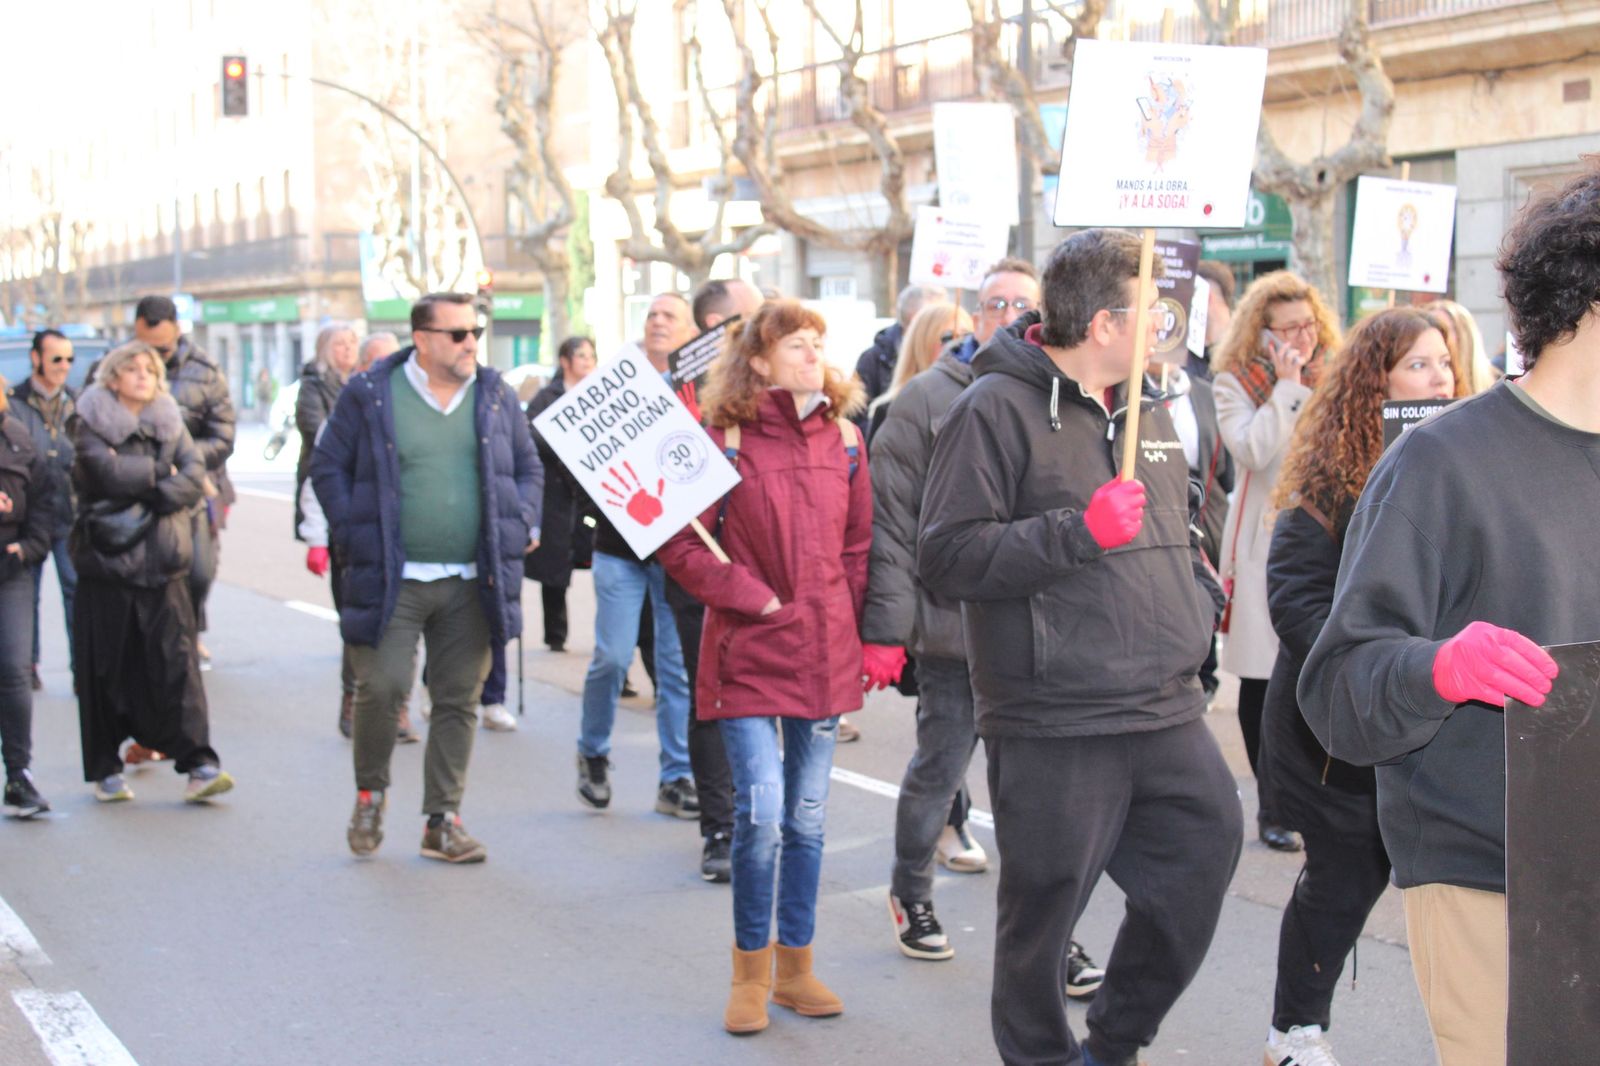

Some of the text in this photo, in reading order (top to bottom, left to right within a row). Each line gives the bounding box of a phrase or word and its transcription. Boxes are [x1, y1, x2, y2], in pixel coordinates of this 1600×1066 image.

[1116, 179, 1144, 191] MANOS
[1146, 180, 1152, 192] A
[1154, 181, 1164, 192] LA
[1119, 194, 1190, 210] ¡Y A LA SOGA!
[551, 359, 637, 434] TRABAJO
[579, 389, 648, 444] DIGNO,
[1383, 407, 1400, 420] SIN
[580, 435, 625, 473] VIDA
[621, 395, 674, 441] DIGNA
[668, 443, 691, 467] 30
[684, 461, 694, 471] N
